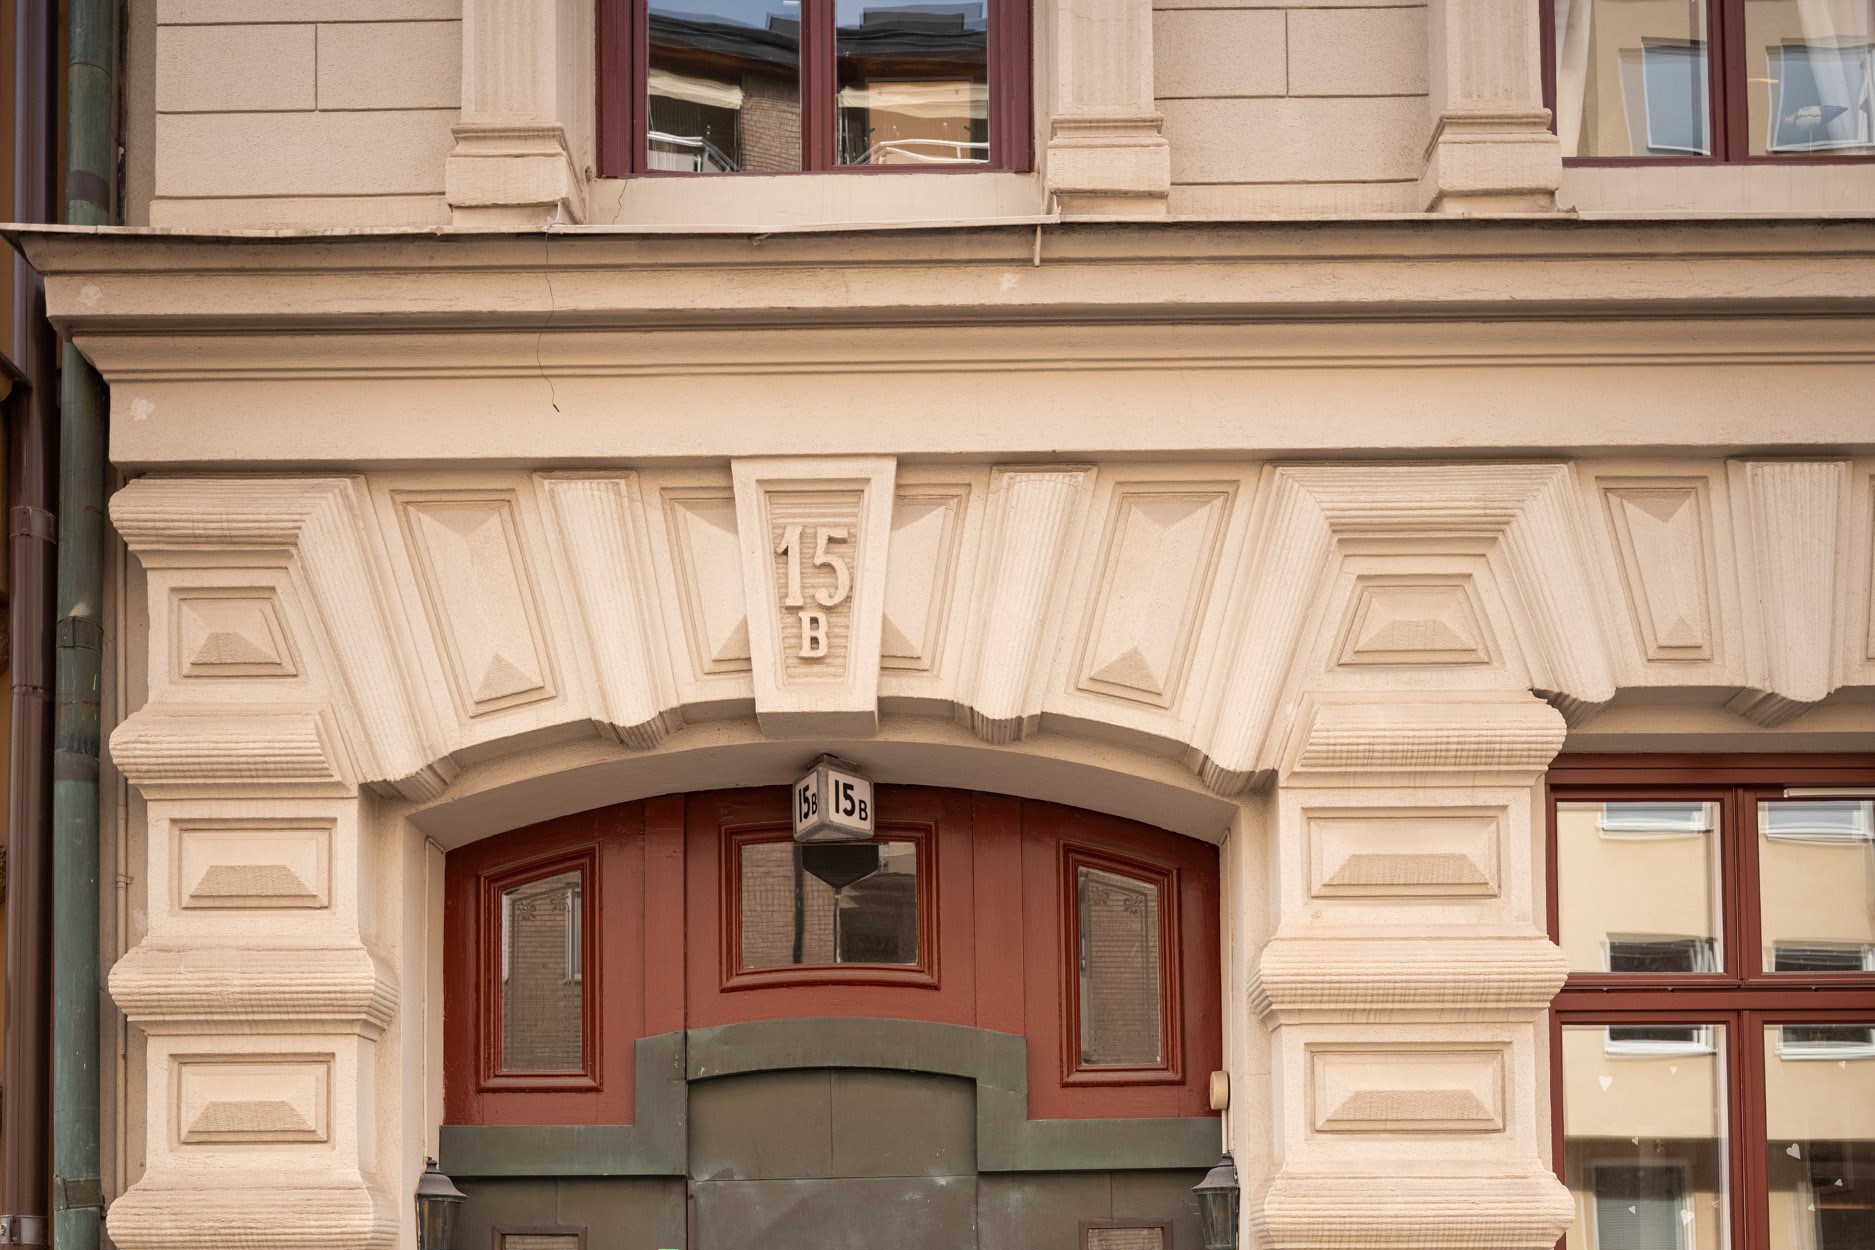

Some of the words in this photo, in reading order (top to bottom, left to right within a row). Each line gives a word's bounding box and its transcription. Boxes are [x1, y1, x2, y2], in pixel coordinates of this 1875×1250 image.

[776, 525, 851, 609] 15
[798, 611, 829, 659] B
[834, 779, 868, 822] 15B
